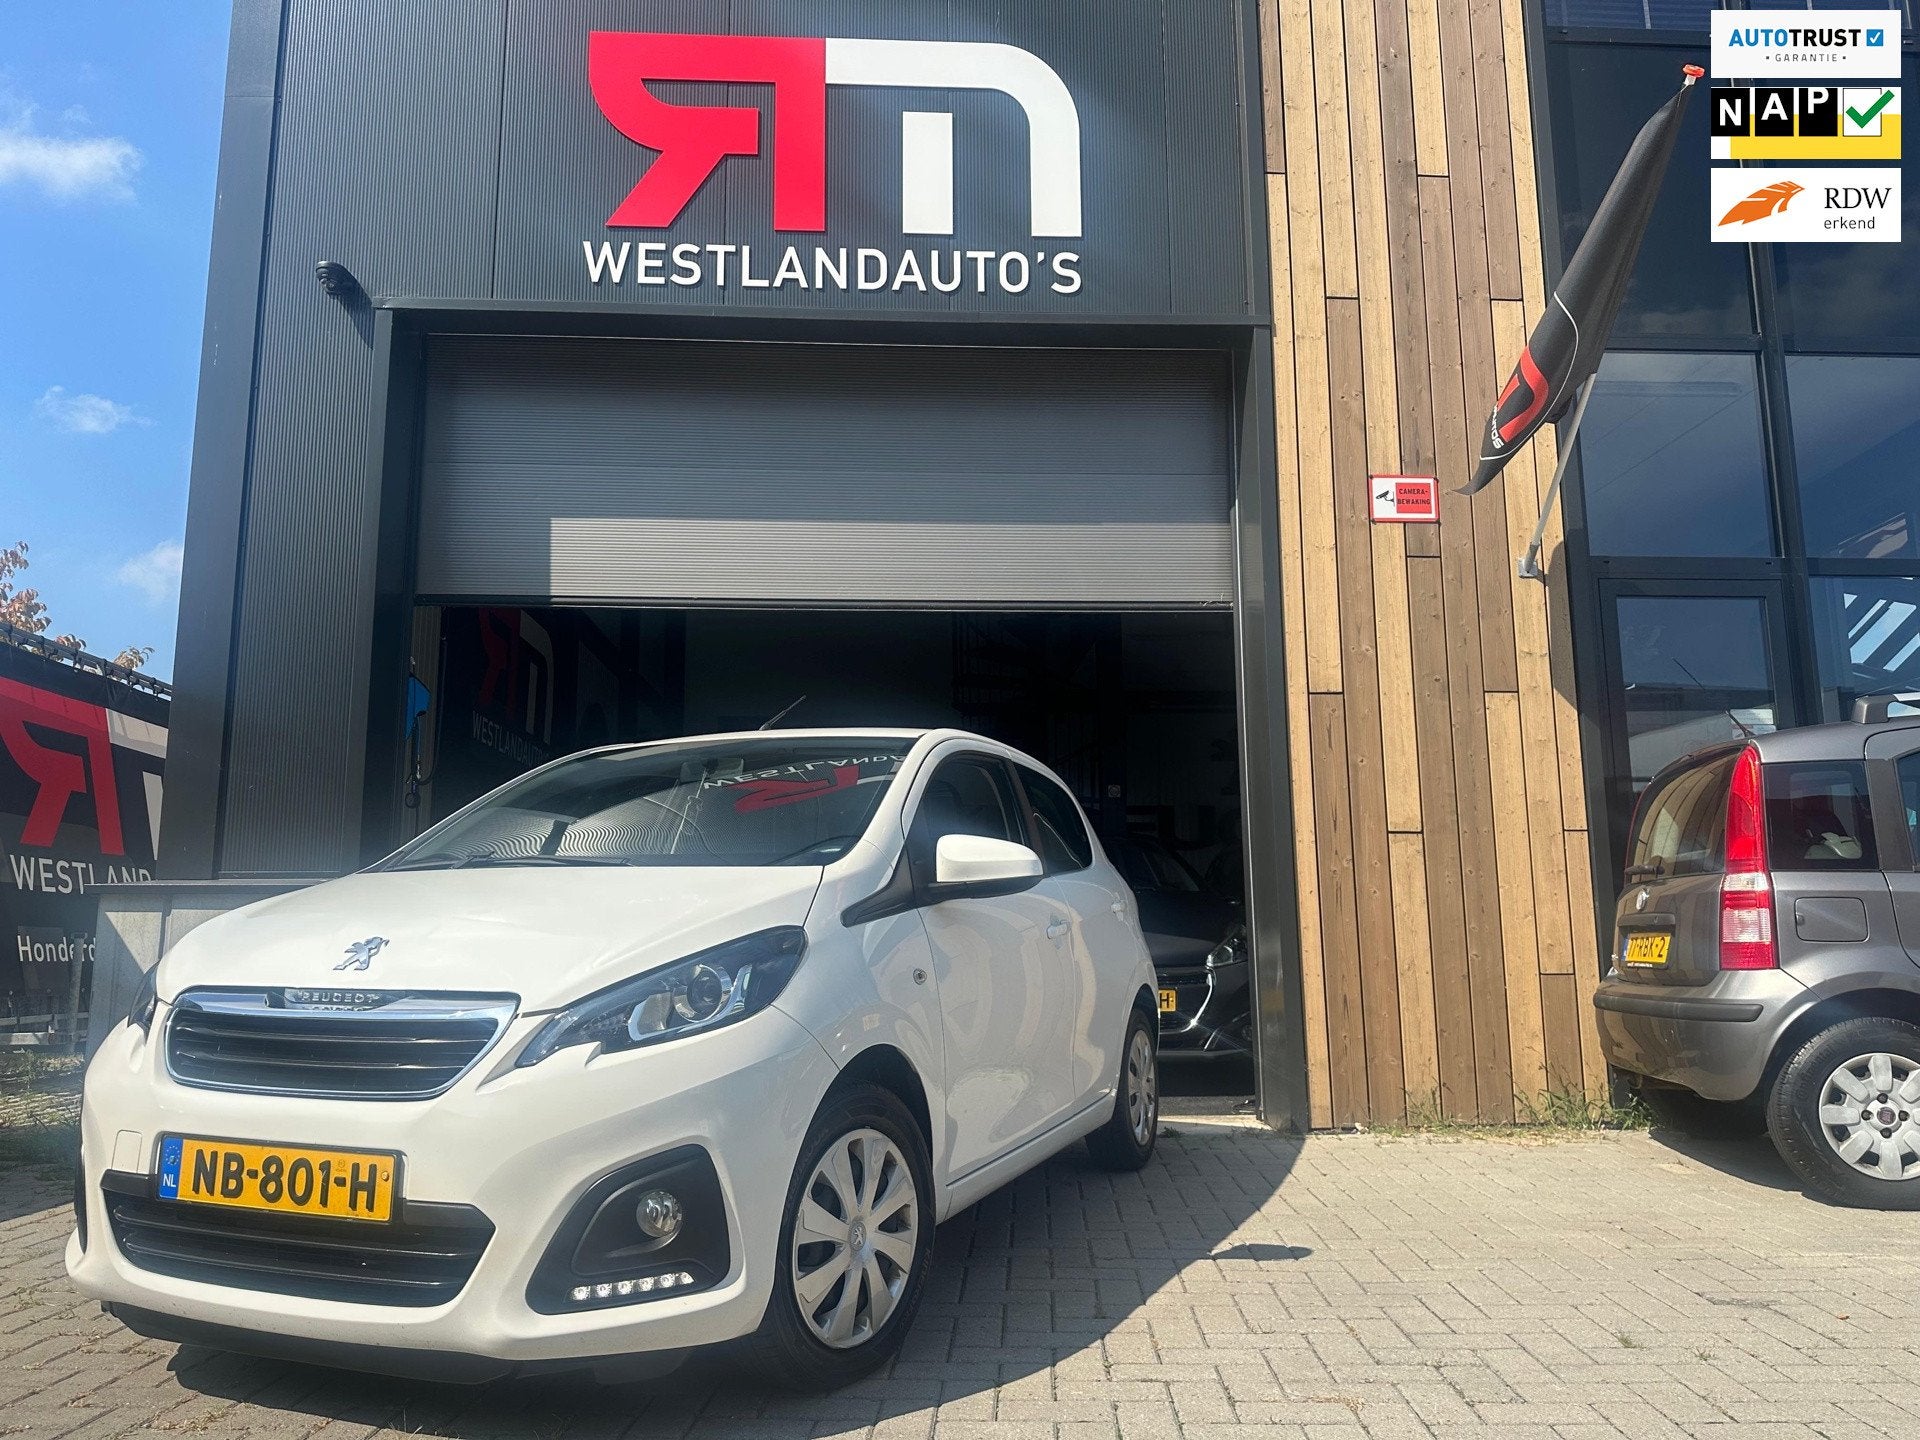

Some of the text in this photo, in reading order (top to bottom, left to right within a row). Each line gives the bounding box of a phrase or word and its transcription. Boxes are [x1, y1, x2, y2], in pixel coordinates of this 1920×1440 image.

[582, 239, 1083, 294] WESTLANDAUTO'S
[1398, 488, 1429, 496] CAMERA-
[301, 992, 380, 1003] PEUGEOT
[162, 1173, 177, 1188] NL
[191, 1148, 378, 1213] NB-801-H
